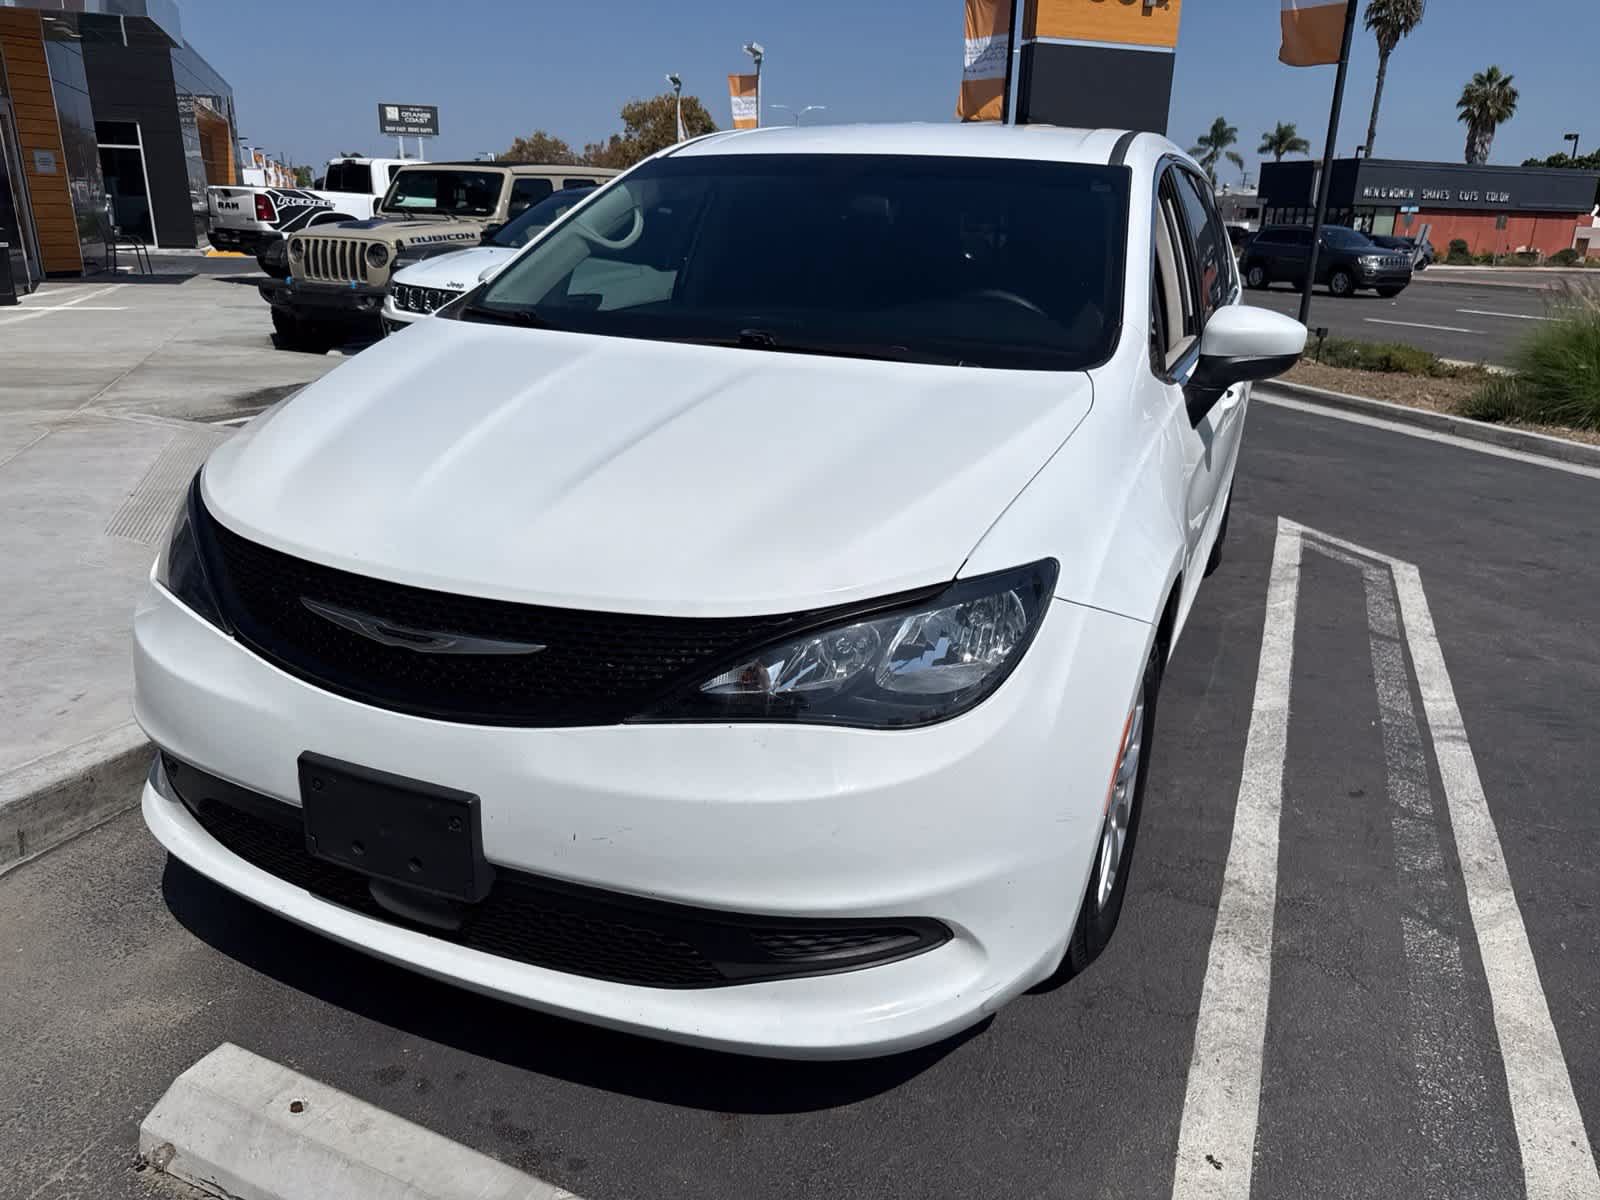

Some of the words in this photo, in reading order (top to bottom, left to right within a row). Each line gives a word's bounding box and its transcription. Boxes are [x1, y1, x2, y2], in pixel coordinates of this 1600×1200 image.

[1363, 187, 1379, 198] MEN
[1389, 189, 1415, 199] WOMEN
[1422, 189, 1451, 200] SHAVES
[1459, 191, 1479, 201] CUTS
[1485, 191, 1510, 202] COLOR
[218, 201, 239, 210] RAM
[409, 232, 476, 244] RUBICON
[446, 281, 465, 289] Jeep
